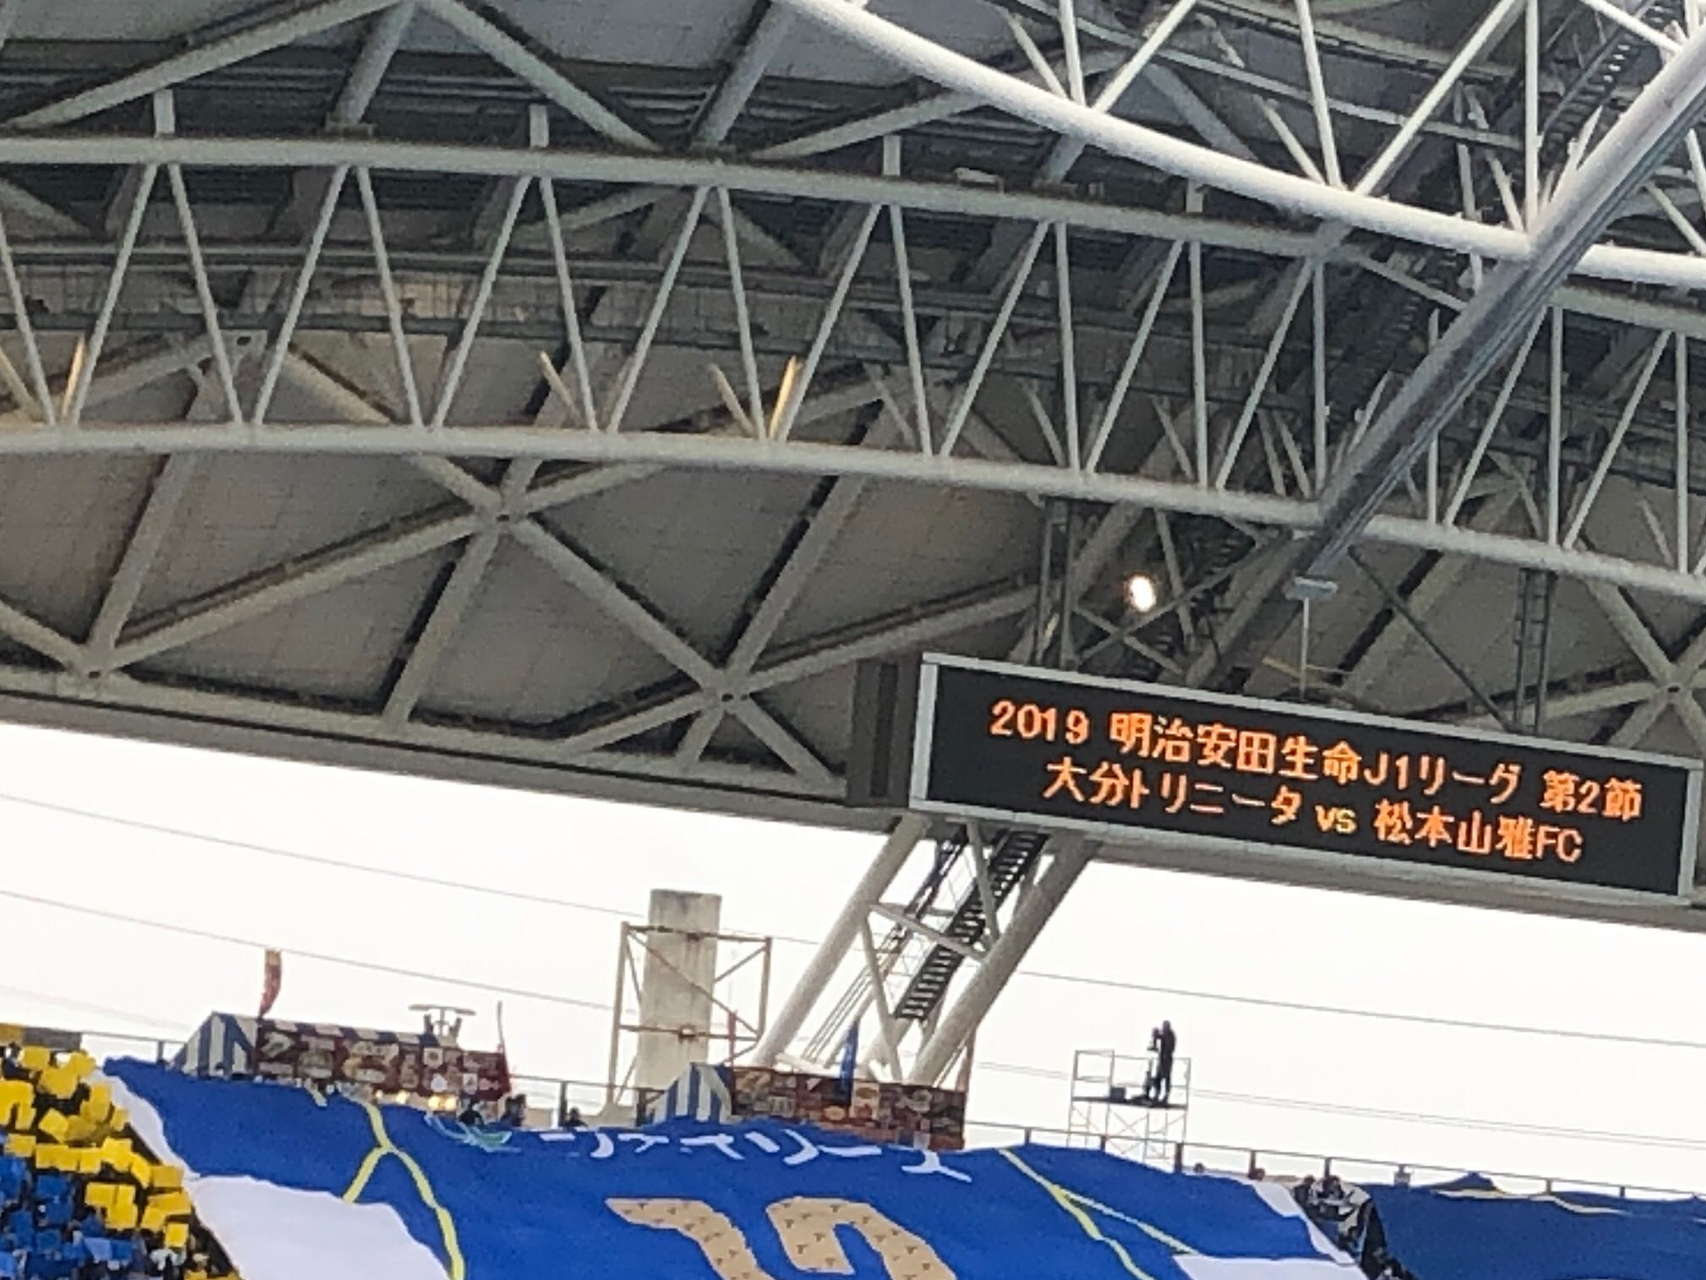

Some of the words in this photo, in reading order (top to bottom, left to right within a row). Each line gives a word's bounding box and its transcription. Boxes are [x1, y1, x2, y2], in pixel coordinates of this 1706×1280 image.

[990, 699, 1091, 745] 2019
[1110, 712, 1518, 800] 明治安田生命J1リーグ
[1543, 769, 1644, 822] 第2節
[1043, 757, 1302, 832] 大分トリニータ
[1316, 803, 1357, 834] vs
[1374, 799, 1584, 863] 松本山雅FC
